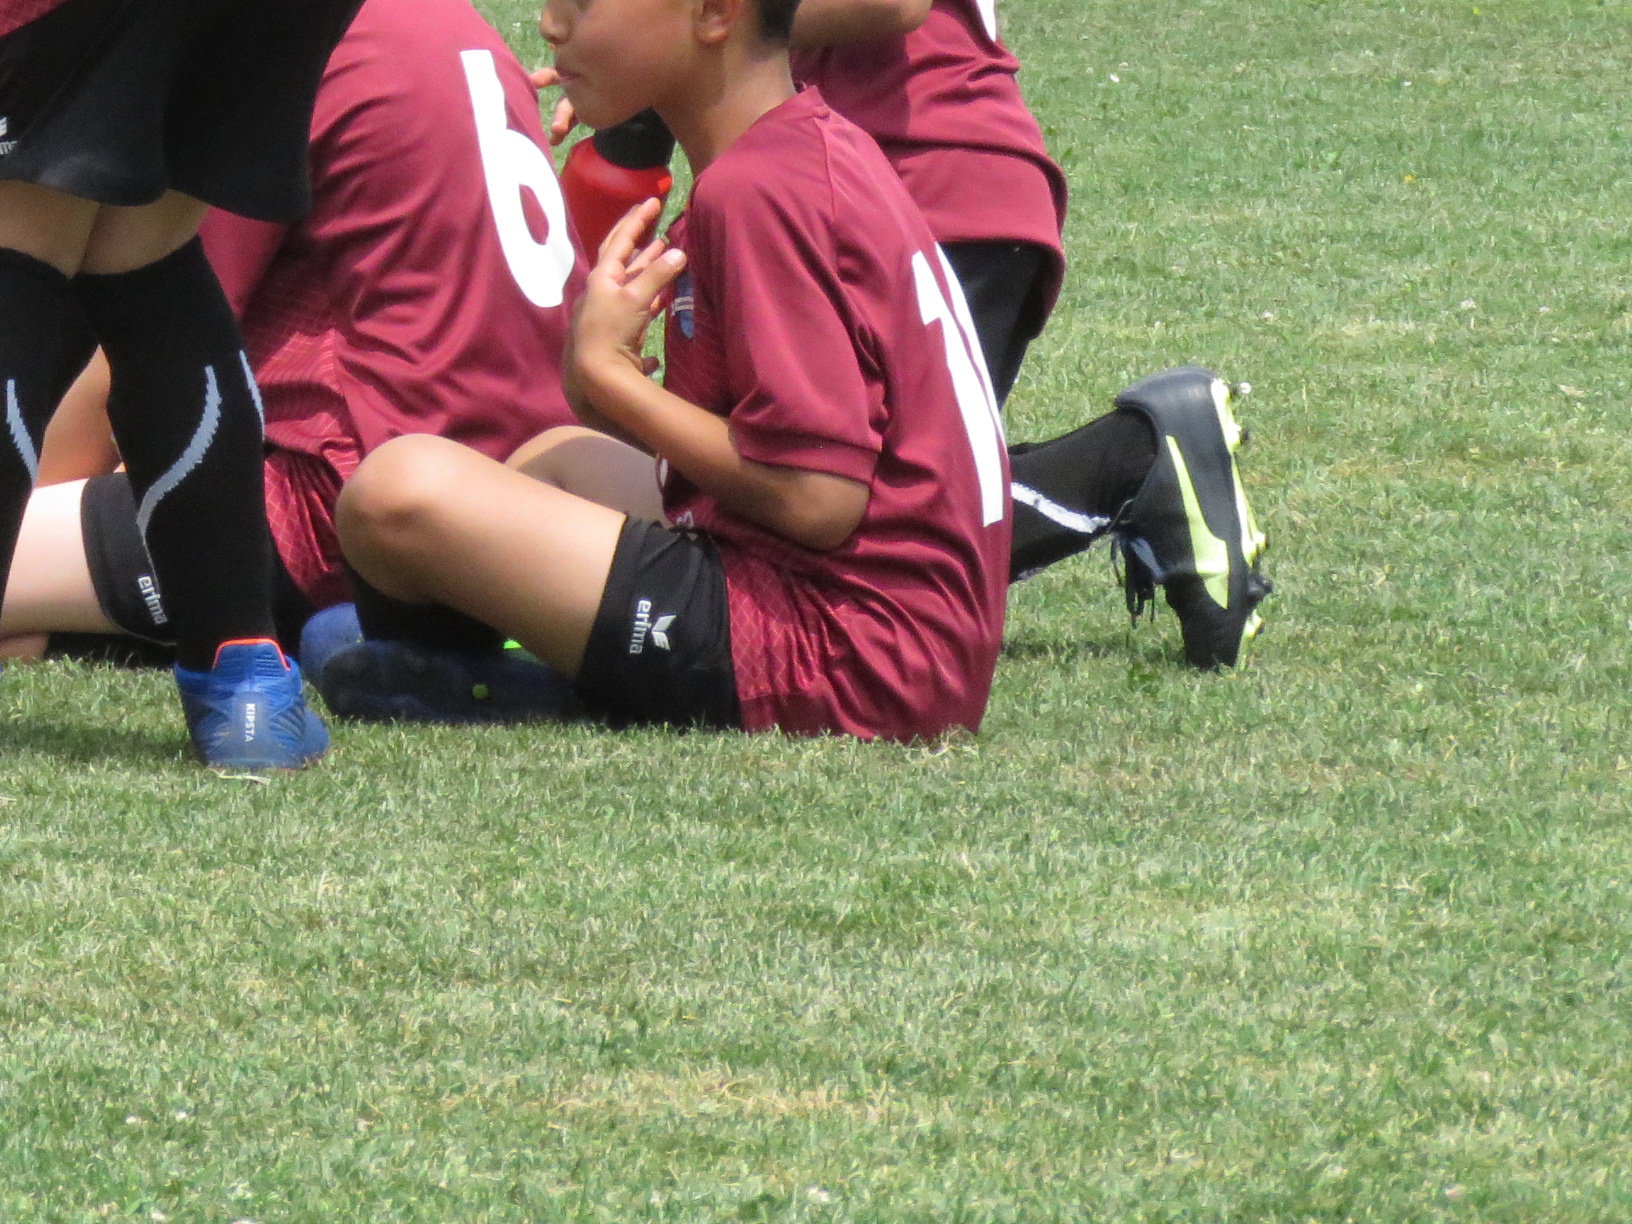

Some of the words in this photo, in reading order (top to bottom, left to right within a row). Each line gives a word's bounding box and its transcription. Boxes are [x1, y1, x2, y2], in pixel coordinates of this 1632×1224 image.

[457, 48, 576, 309] 6
[137, 576, 168, 626] erima
[629, 599, 652, 655] erima
[244, 703, 256, 743] KIPSTA
